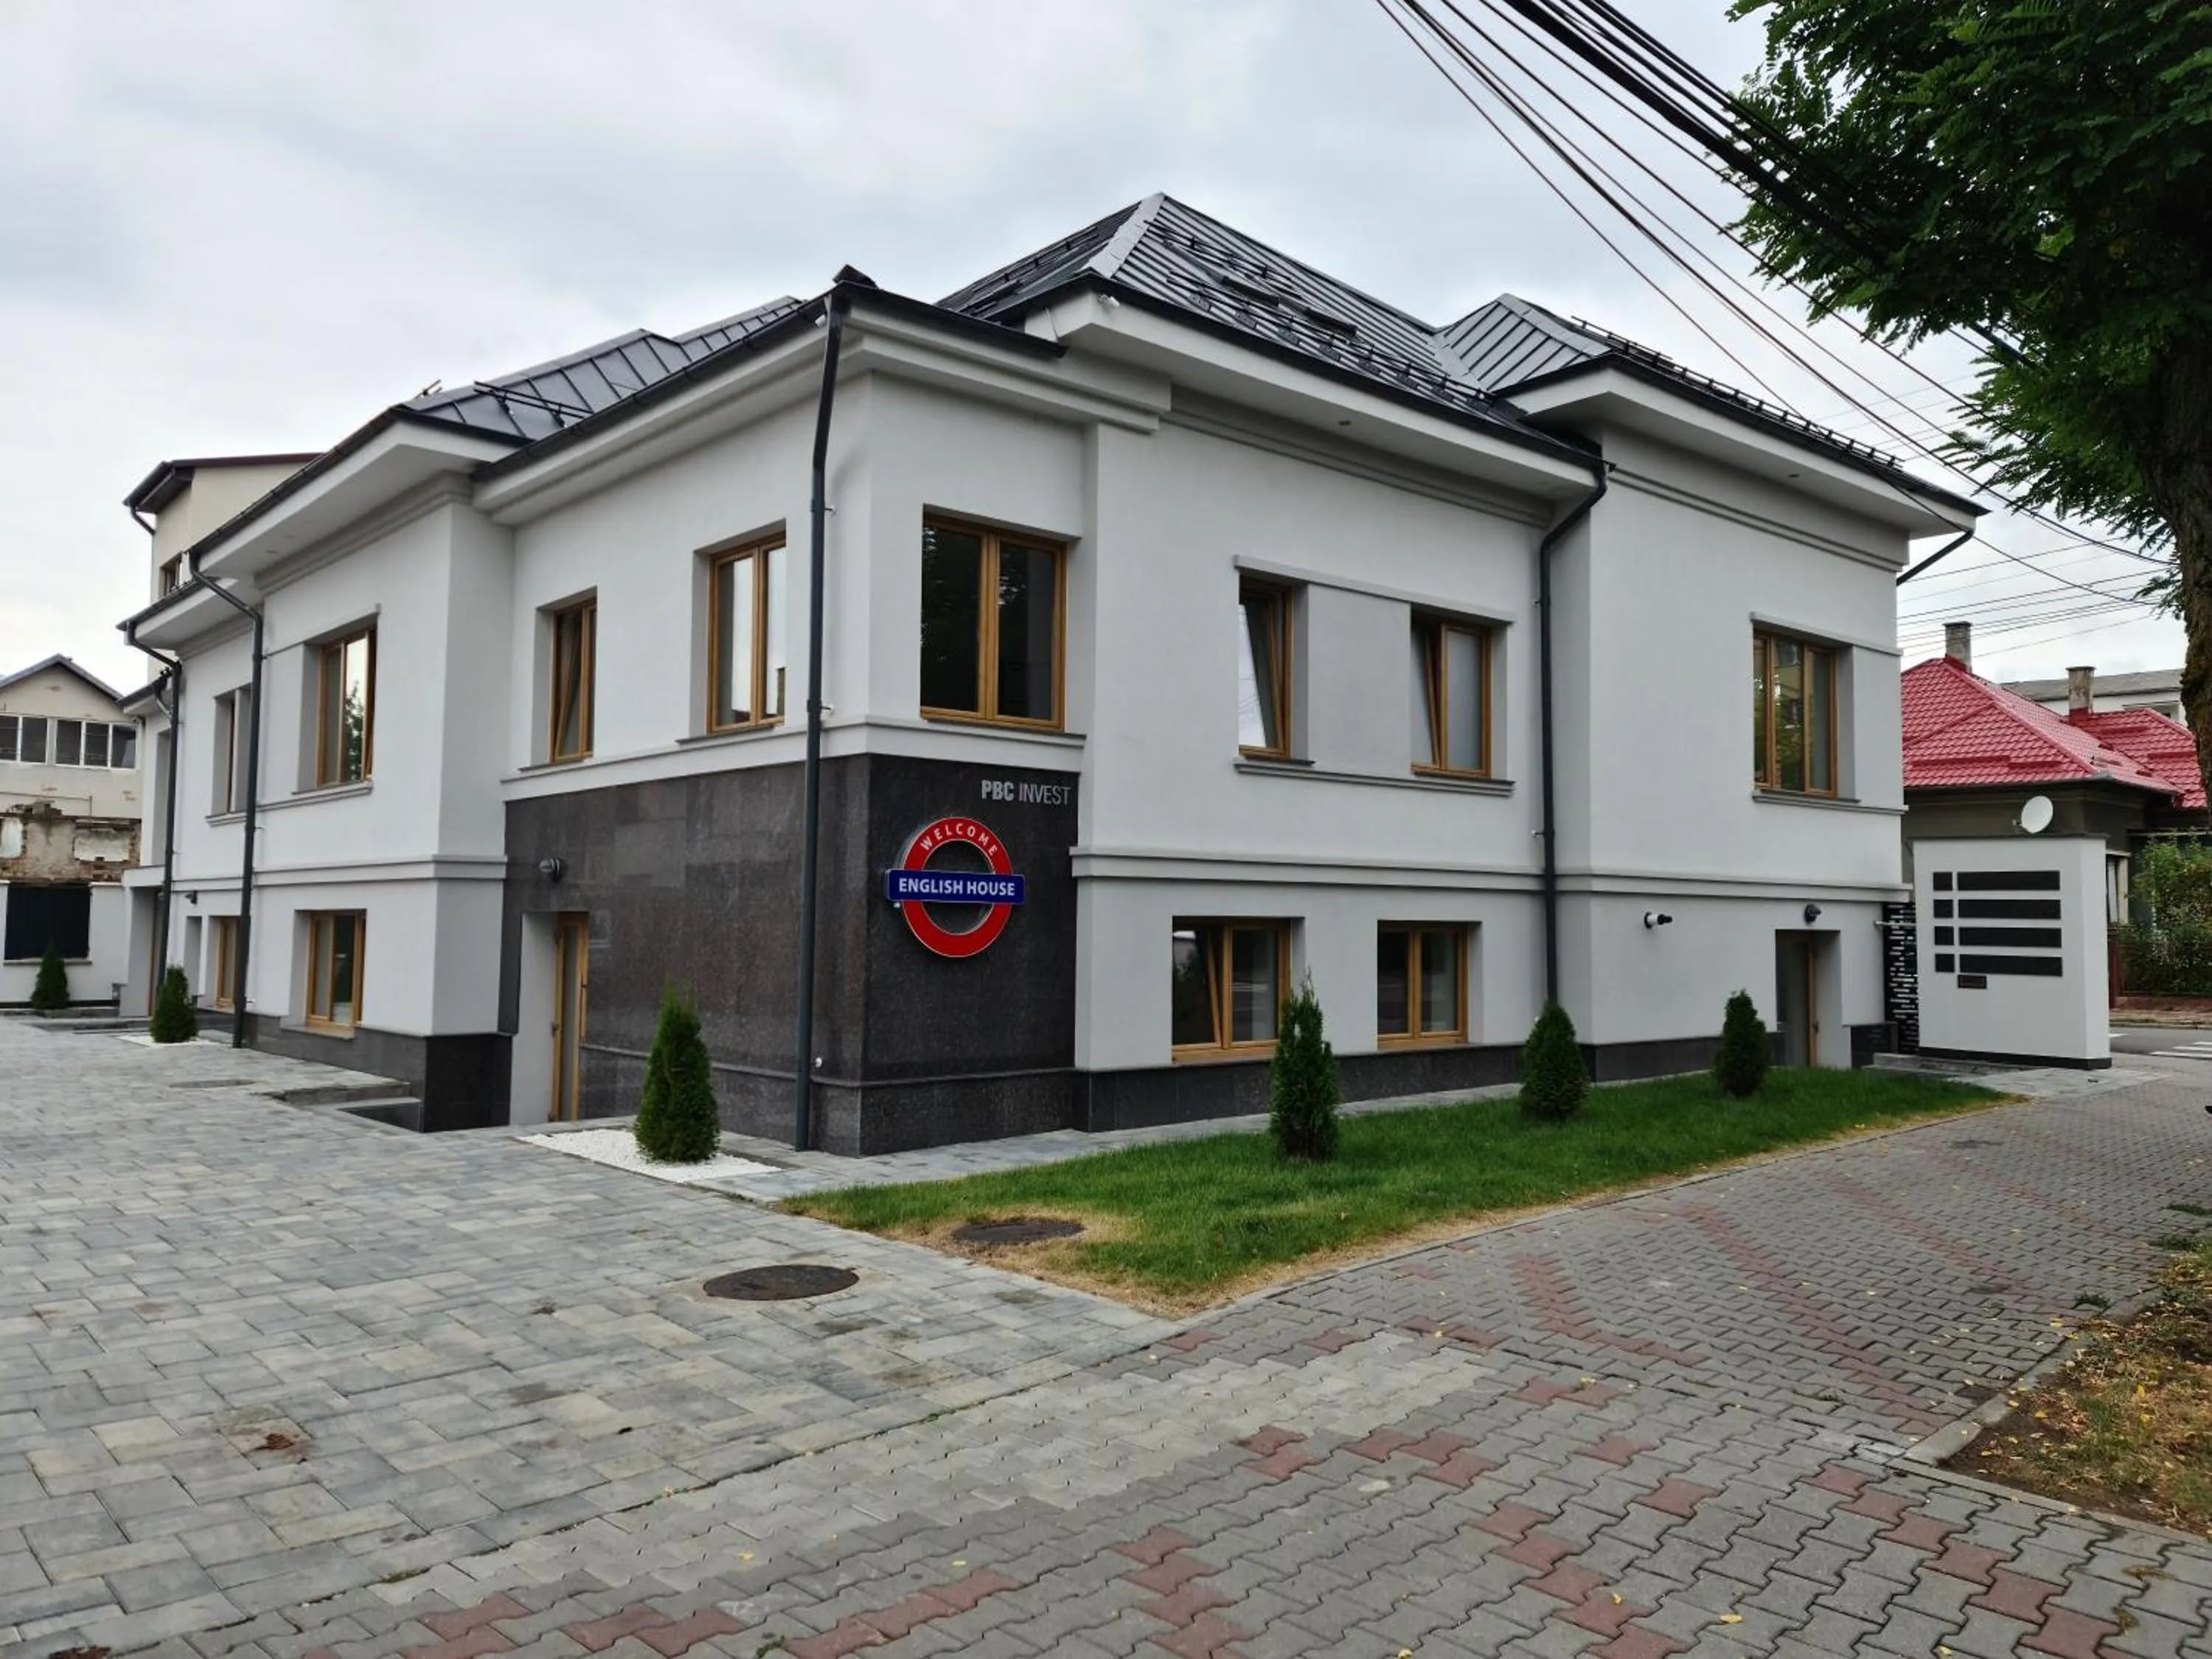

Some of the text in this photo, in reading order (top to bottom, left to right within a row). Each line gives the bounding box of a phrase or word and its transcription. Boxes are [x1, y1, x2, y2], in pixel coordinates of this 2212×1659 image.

[981, 779, 1071, 805] PBC INVEST
[919, 822, 998, 858] WELCOME
[898, 877, 1015, 897] ENGLISH HOUSE
